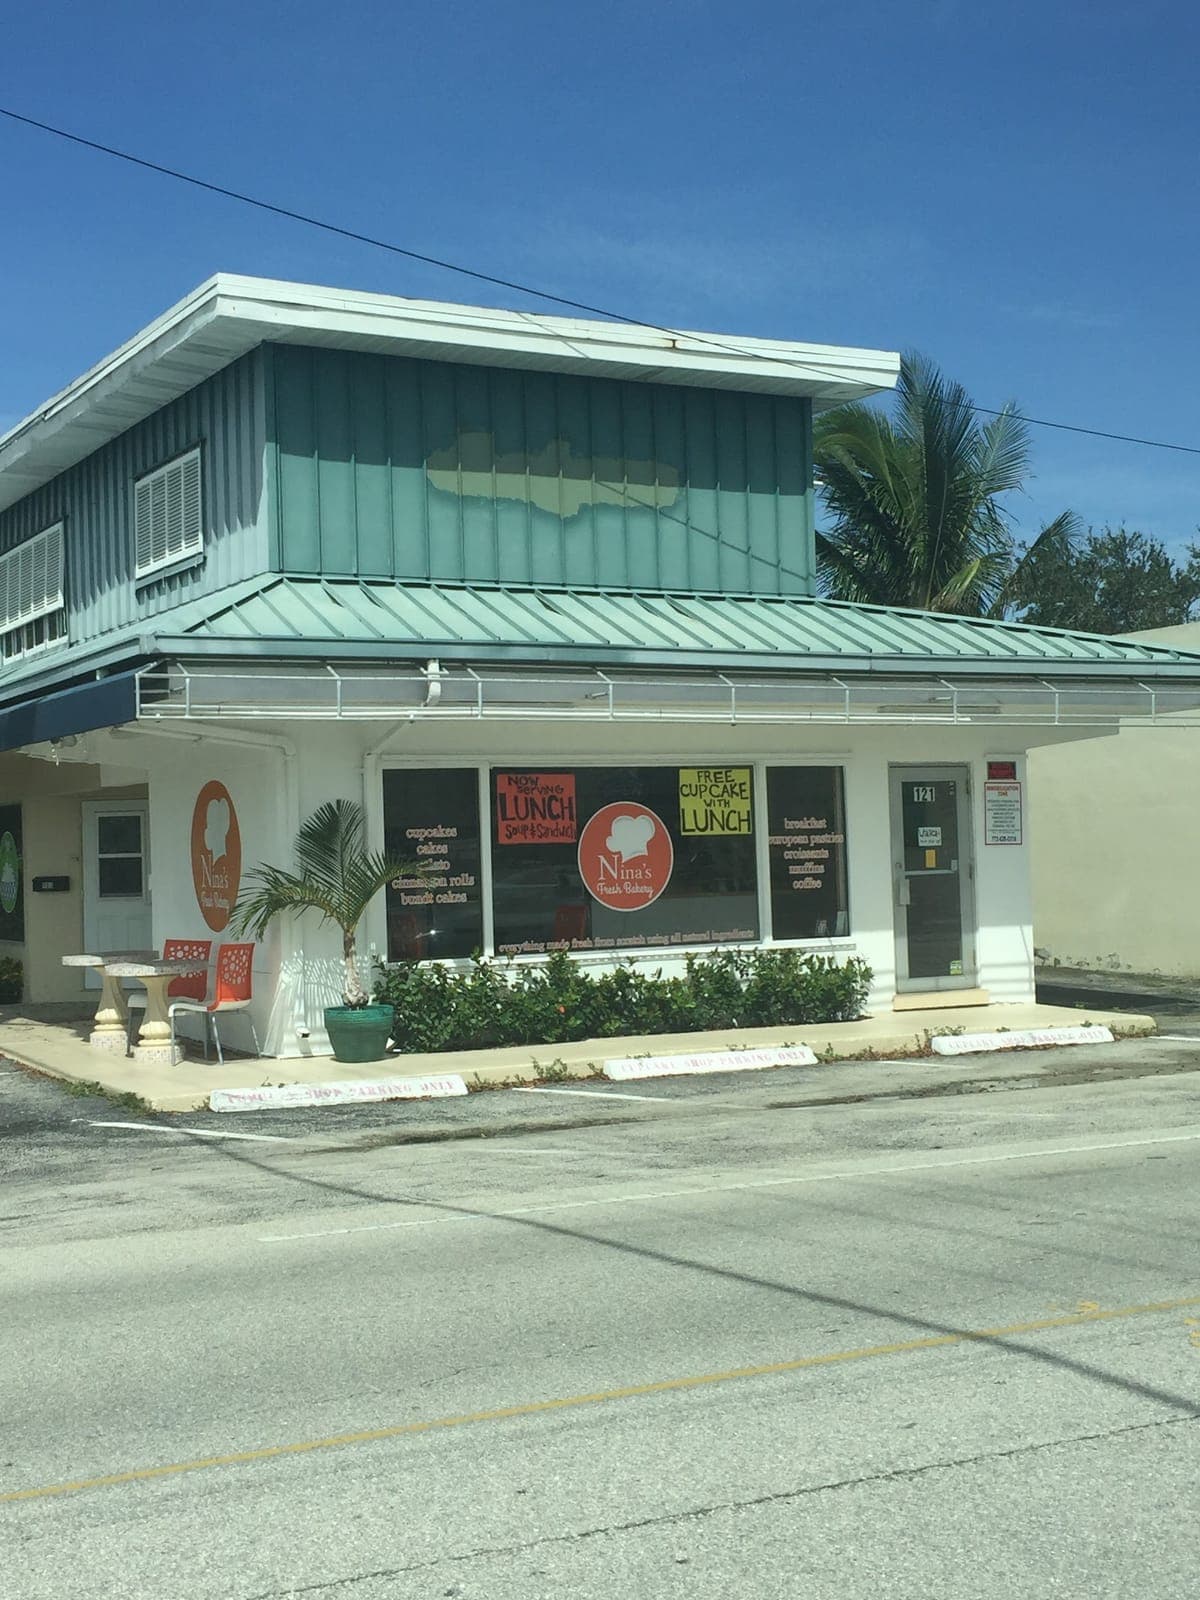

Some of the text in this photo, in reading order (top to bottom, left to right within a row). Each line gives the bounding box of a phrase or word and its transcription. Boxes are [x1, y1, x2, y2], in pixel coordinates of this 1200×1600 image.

[508, 776, 540, 786] NOW
[697, 770, 735, 783] FREE
[680, 782, 749, 800] CUPCAKE
[914, 787, 935, 801] 121
[499, 793, 575, 821] LUNCH
[704, 799, 730, 808] WITH
[681, 809, 751, 833] LUNCH
[406, 825, 457, 841] cupcakes
[505, 824, 528, 840] Soup
[416, 842, 448, 855] cakes
[200, 854, 229, 888] Nina's
[598, 854, 652, 881] Nina's
[449, 873, 475, 887] rolls
[792, 877, 822, 889] coffee
[597, 881, 654, 898] Fresh Bakery
[400, 891, 467, 905] bundt cakes
[499, 940, 545, 953] everything
